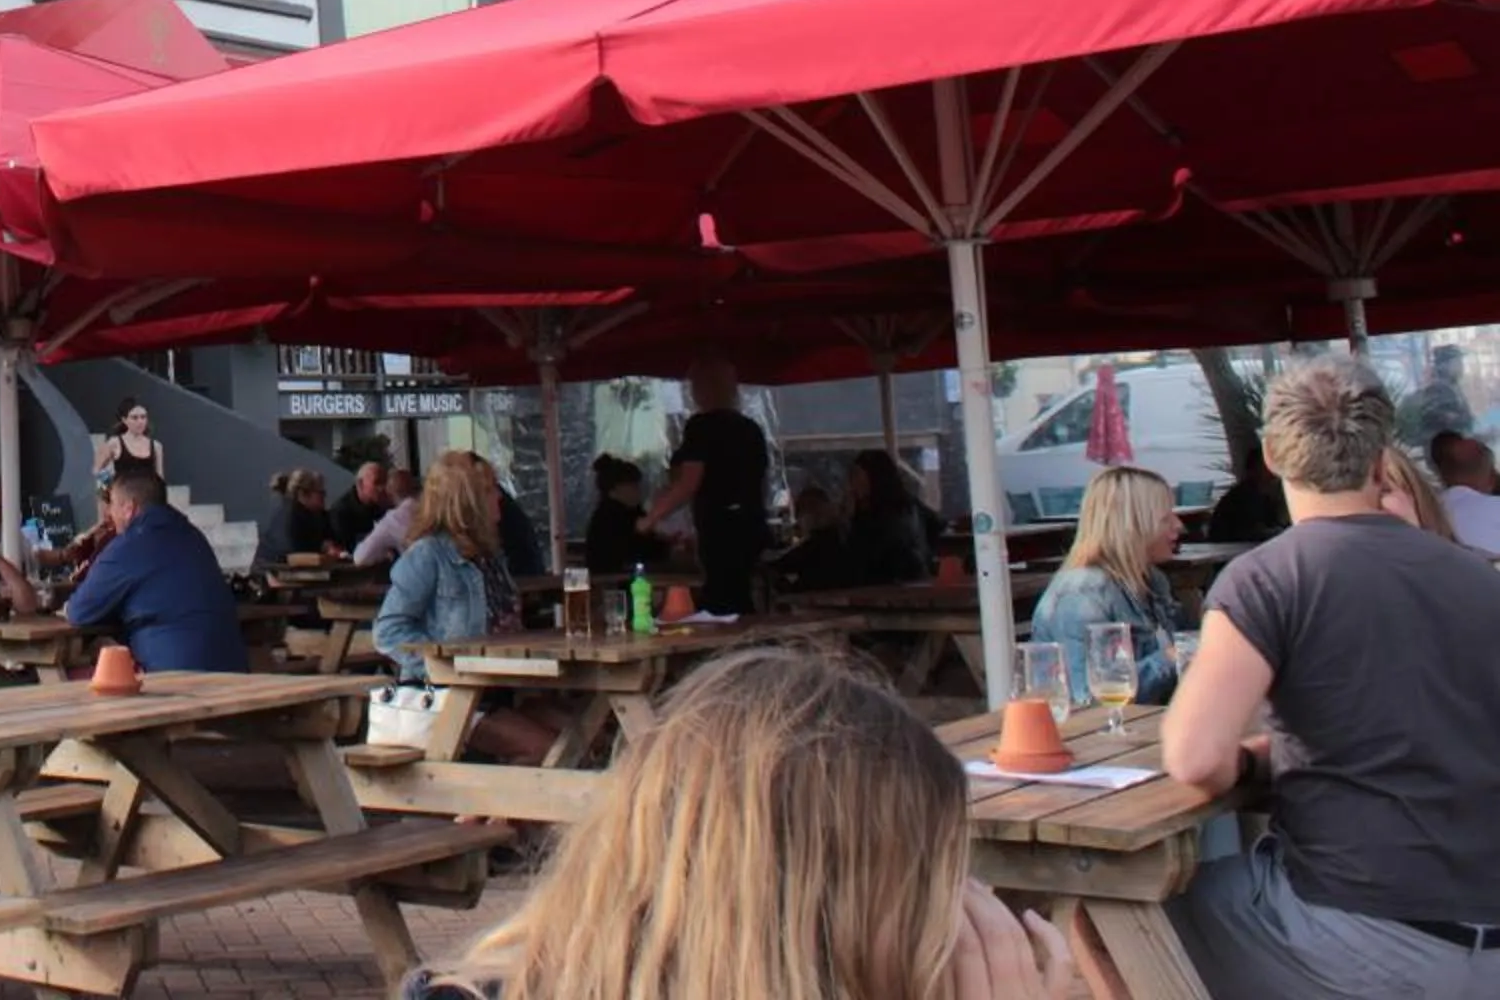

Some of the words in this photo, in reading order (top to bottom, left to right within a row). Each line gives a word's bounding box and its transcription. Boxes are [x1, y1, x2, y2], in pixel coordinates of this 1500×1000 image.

[291, 394, 365, 414] BURGERS
[385, 394, 417, 413] LIVE
[419, 394, 463, 413] MUSIC
